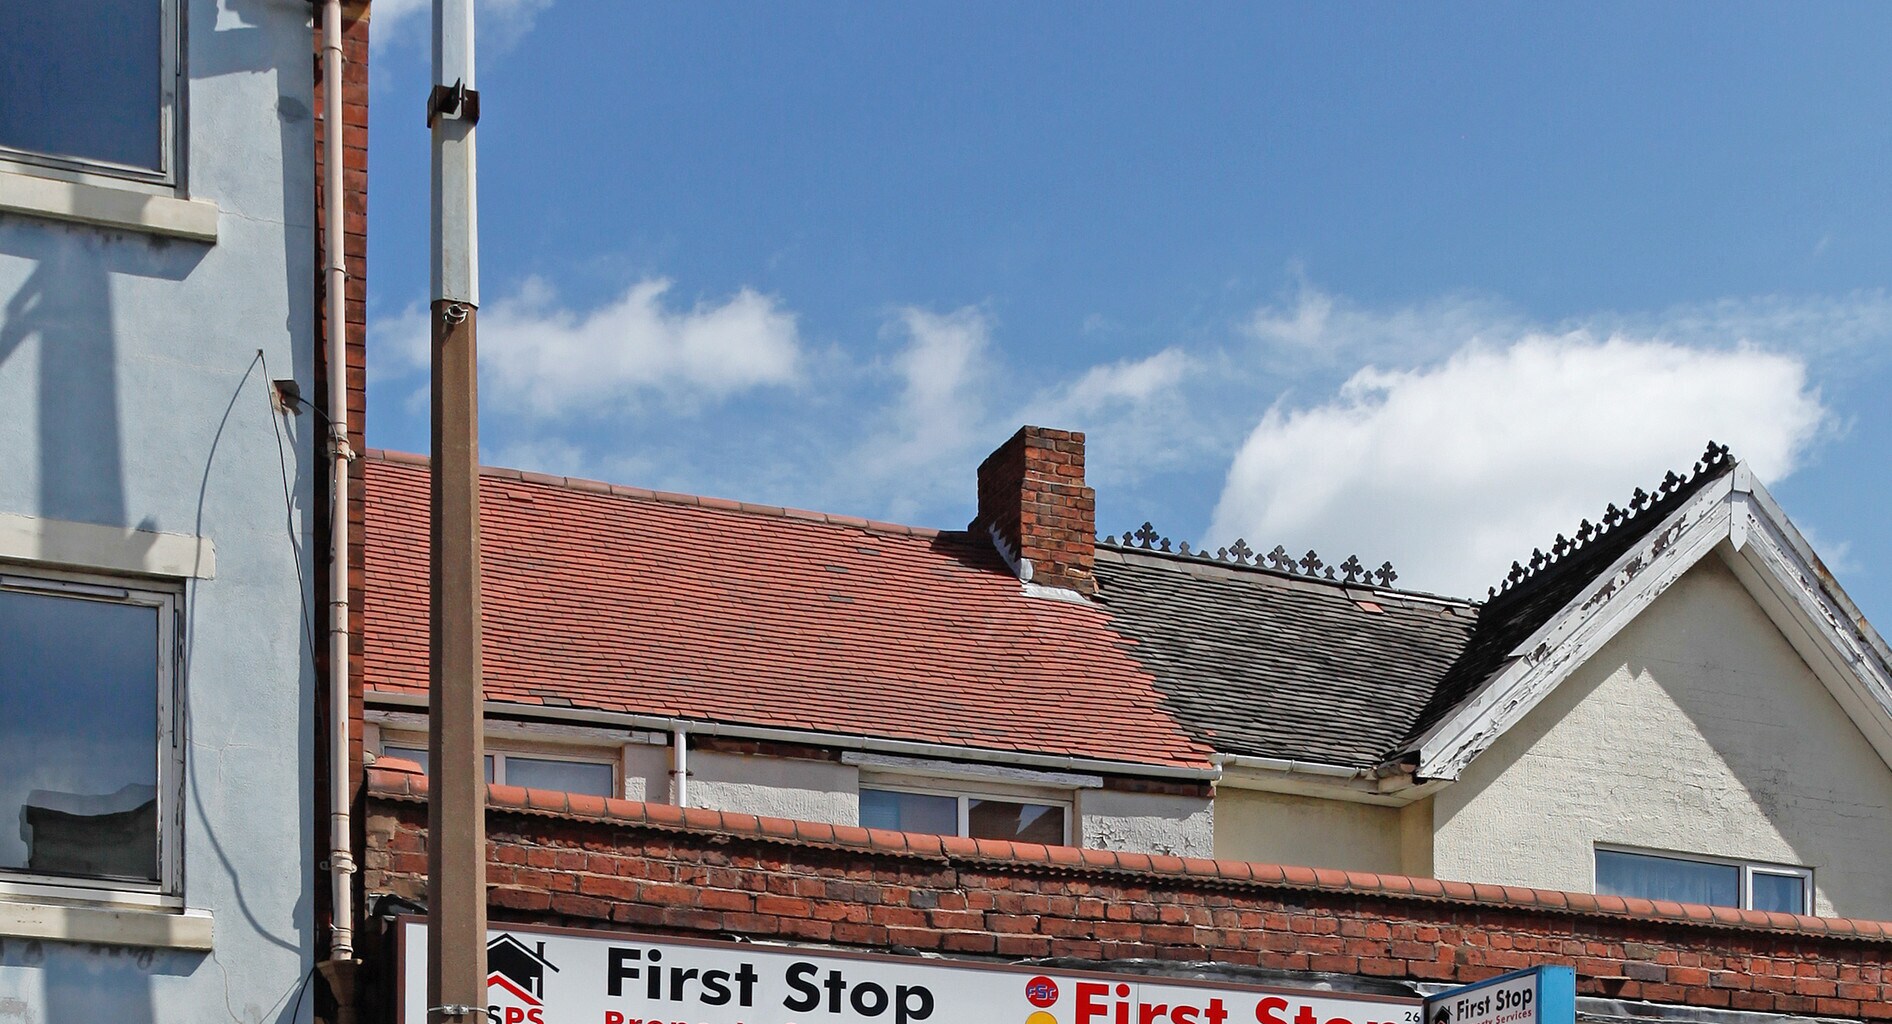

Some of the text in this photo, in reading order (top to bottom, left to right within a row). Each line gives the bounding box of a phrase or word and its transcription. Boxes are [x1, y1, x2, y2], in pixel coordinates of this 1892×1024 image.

[607, 947, 758, 1008] First
[1456, 988, 1533, 1021] First Stop
[1495, 1009, 1532, 1024] Services
[1404, 1010, 1421, 1024] 26
